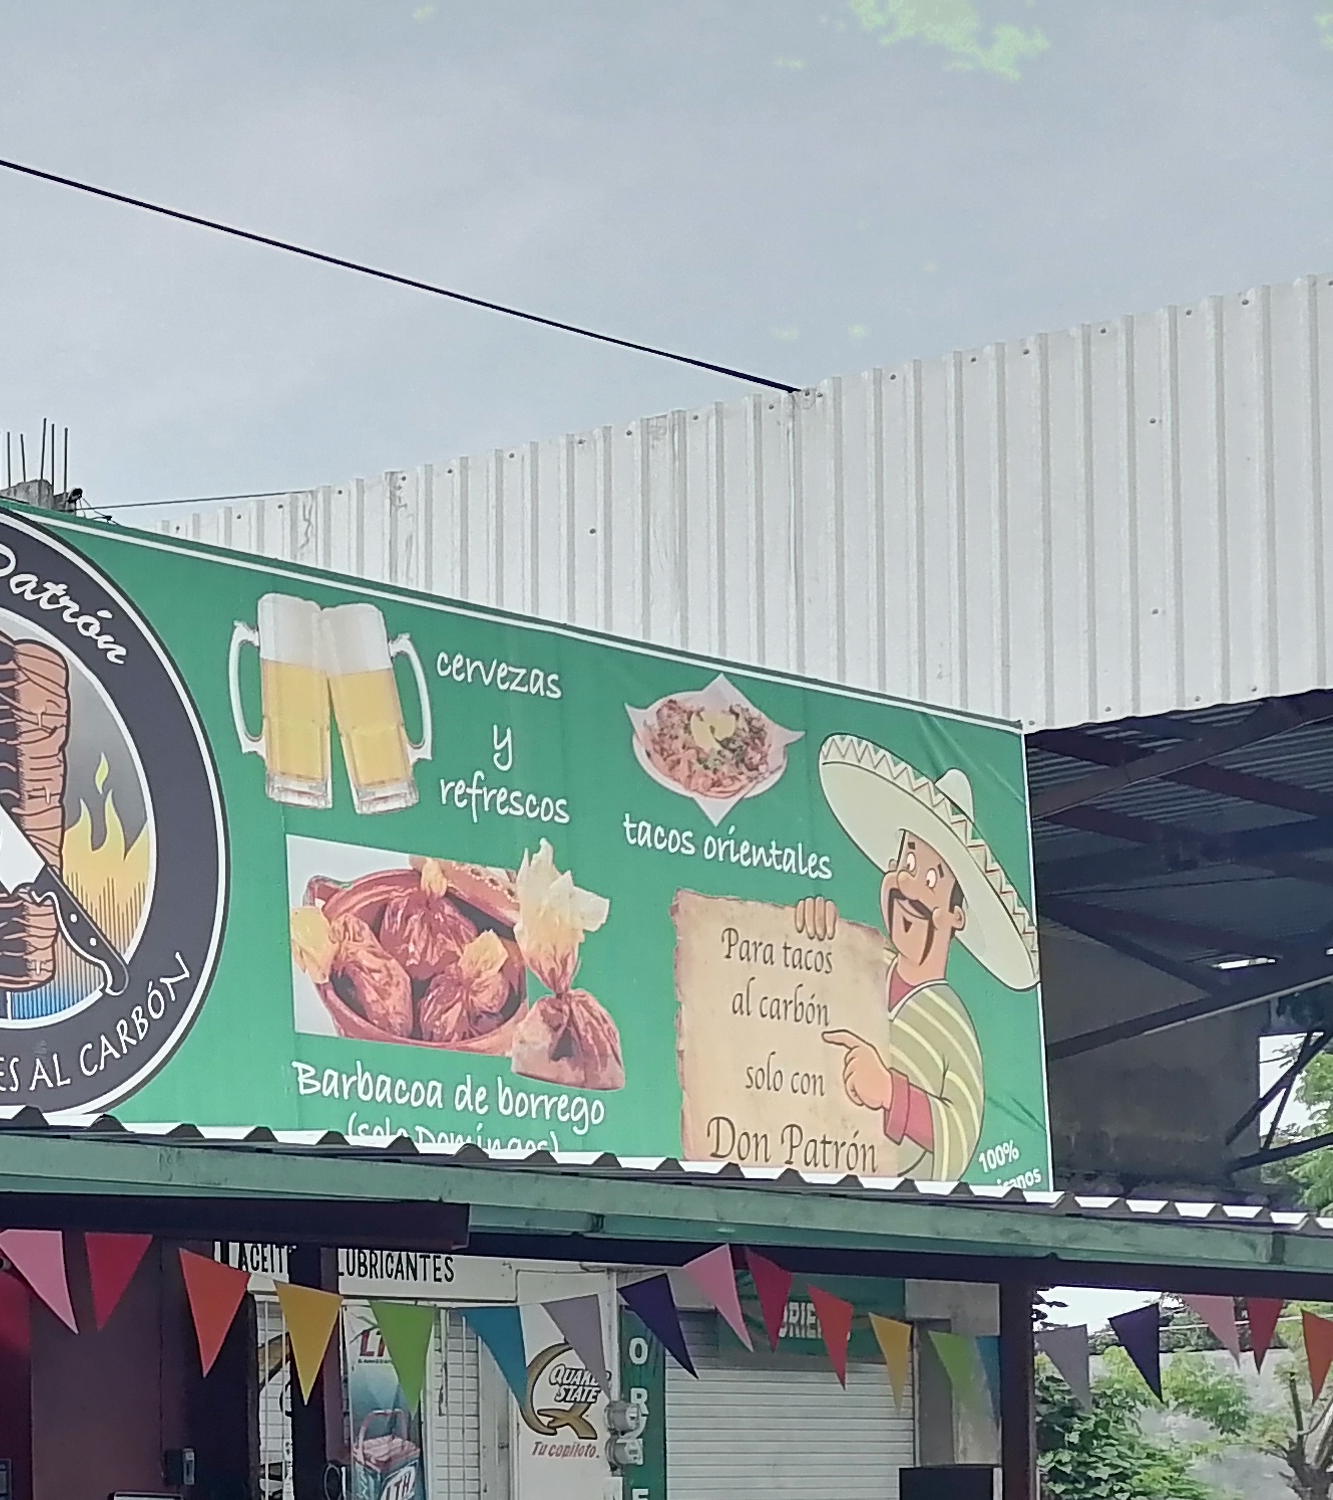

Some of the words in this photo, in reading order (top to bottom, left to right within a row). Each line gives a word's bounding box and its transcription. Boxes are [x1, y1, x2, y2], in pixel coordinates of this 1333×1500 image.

[436, 651, 563, 699] cervezas
[492, 724, 514, 770] y
[439, 771, 571, 824] refrescos
[623, 813, 696, 855] tacos
[703, 825, 832, 880] orientales
[721, 927, 776, 966] Para
[783, 938, 833, 974] tacos
[29, 1055, 71, 1093] AL
[79, 952, 193, 1077] CARBÓN
[731, 977, 753, 1016] al
[759, 989, 831, 1028] carbón
[291, 1060, 443, 1110] Barbacoa
[454, 1075, 490, 1112] de
[497, 1077, 606, 1136] borrego
[745, 1051, 784, 1094] solo
[790, 1070, 826, 1098] con
[706, 1115, 772, 1163] Don
[780, 1124, 879, 1175] Patrón
[978, 1139, 1020, 1173] 100%
[554, 1385, 602, 1403] STATE
[532, 1441, 548, 1456] Tu
